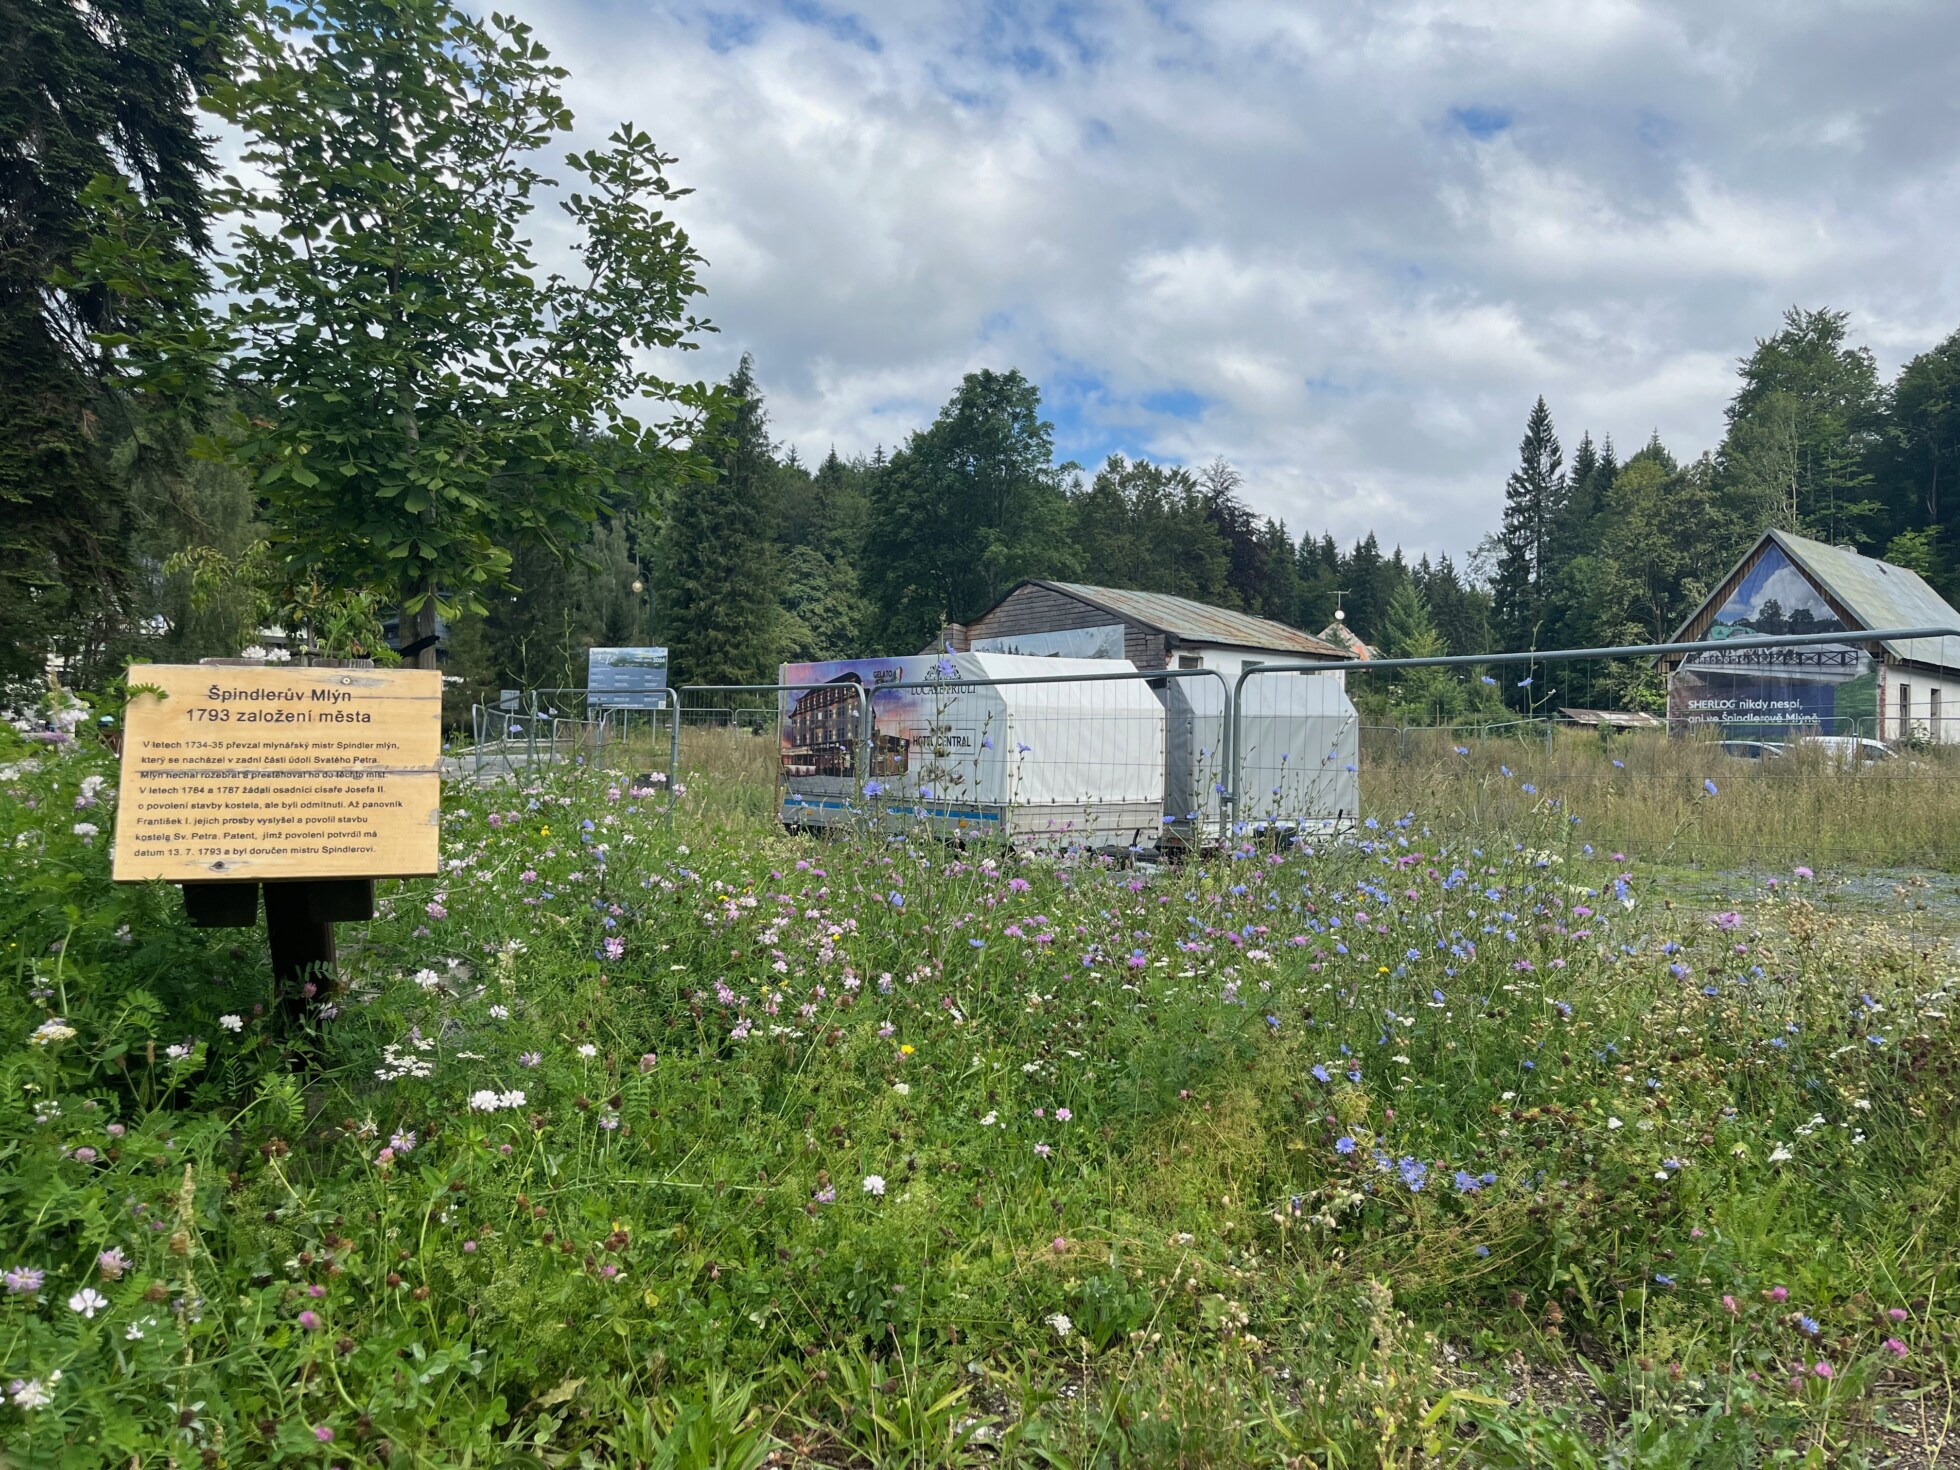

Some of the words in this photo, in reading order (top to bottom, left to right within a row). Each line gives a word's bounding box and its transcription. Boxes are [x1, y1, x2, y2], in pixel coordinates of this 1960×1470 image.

[873, 670, 893, 678] GELATO
[208, 685, 304, 702] Špindlerův
[311, 689, 352, 704] Mlýn
[1688, 700, 1736, 709] SHERLOG
[1739, 699, 1768, 710] nikdy
[1770, 699, 1803, 710] nespí,
[186, 709, 230, 722] 1793
[236, 709, 312, 723] založení
[318, 710, 371, 723] města
[1688, 714, 1704, 723] ani
[1722, 712, 1782, 724] Špindlerově
[1786, 713, 1821, 725] Mlýně.
[151, 741, 181, 749] letech
[226, 742, 260, 750] převzal
[263, 742, 309, 750] mlynářský
[337, 742, 374, 750] Spindler
[376, 742, 399, 750] mlýn,
[913, 736, 934, 747] HOTEL
[937, 736, 971, 747] CENTRAL
[141, 757, 166, 765] který
[353, 756, 381, 764] Svatého
[353, 756, 381, 766] Petra.
[140, 770, 164, 780] Mlýn
[167, 771, 198, 779] nechal
[201, 771, 240, 779] rozebrat
[251, 771, 306, 780] přestěhoval
[309, 771, 320, 779] ho
[322, 771, 334, 779] do
[336, 771, 364, 780] těchto
[217, 786, 240, 794] 1787
[242, 786, 270, 794] žádali
[191, 802, 222, 811] stavby
[282, 802, 298, 810] byli
[193, 817, 219, 826] jejich
[222, 817, 255, 825] prosby
[257, 817, 294, 825] vyslyšel
[305, 816, 335, 825] povolil
[136, 833, 170, 842] kostela
[223, 832, 257, 840] Patent,
[262, 832, 283, 840] jímž
[327, 831, 361, 839] potvrdil
[233, 848, 247, 856] byl
[322, 846, 376, 854] Spindlerovi.
